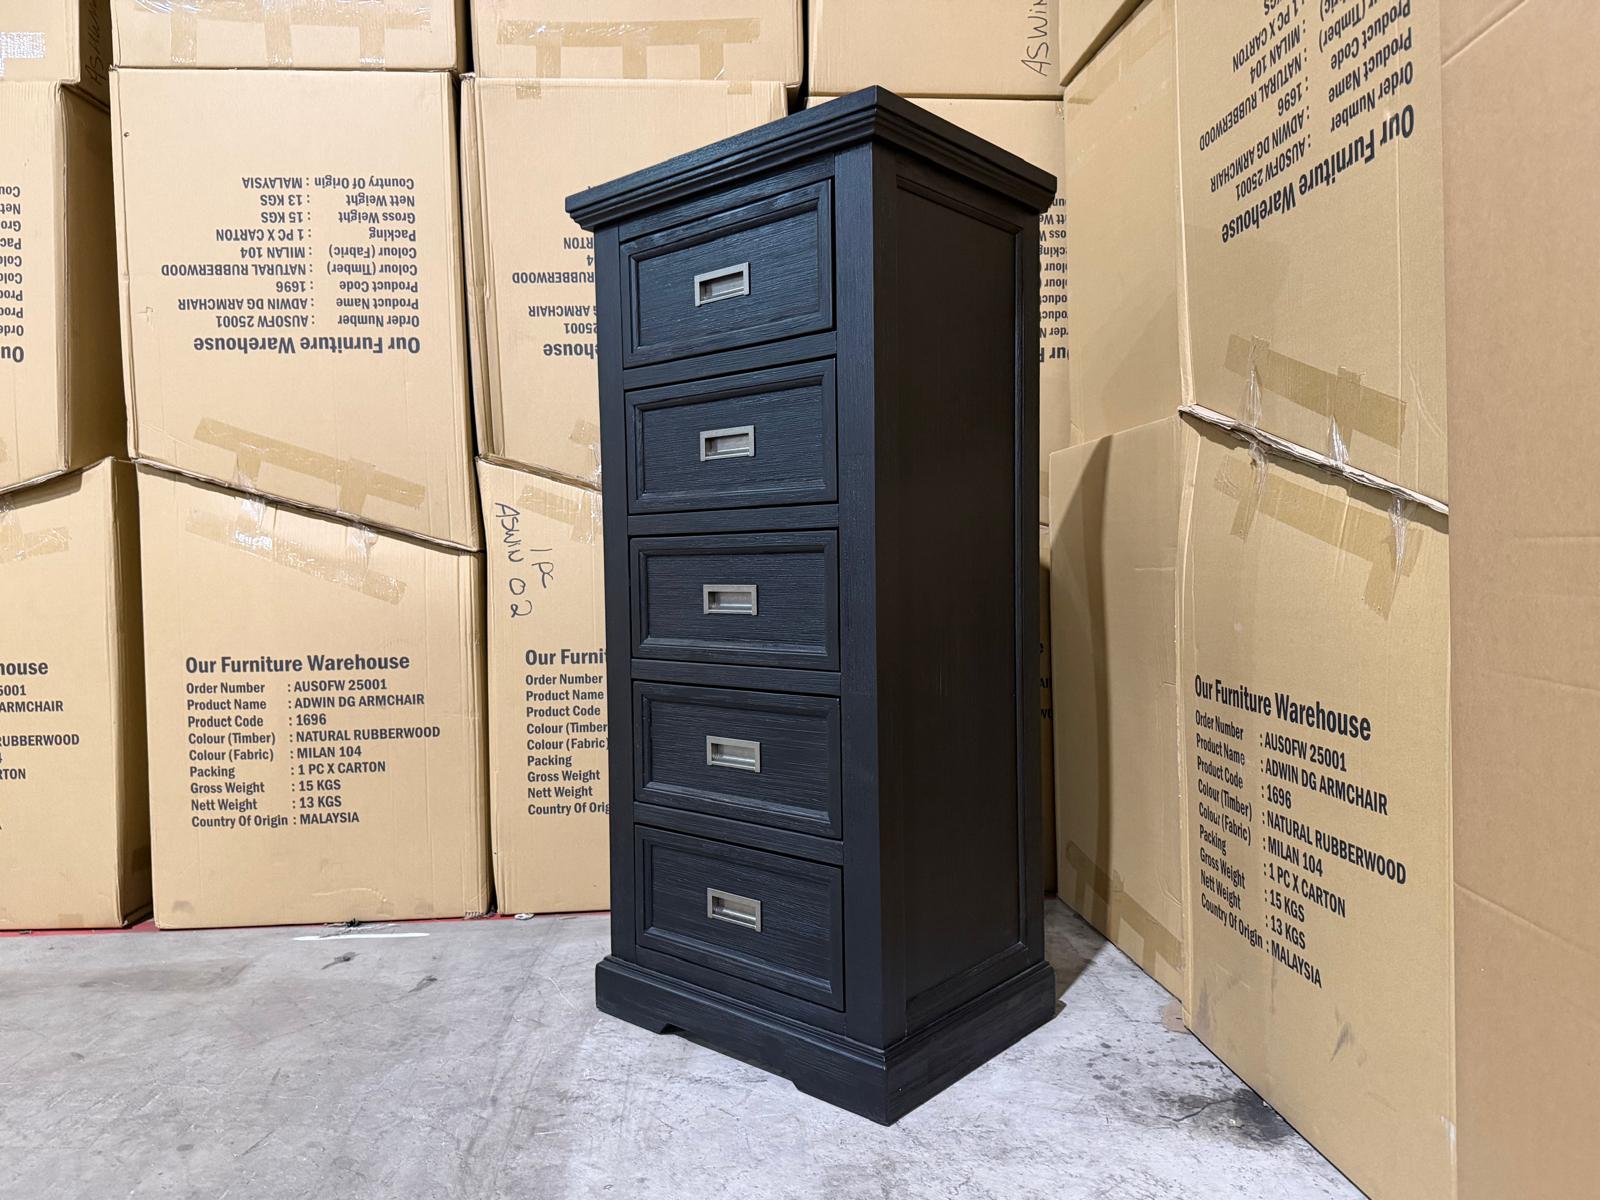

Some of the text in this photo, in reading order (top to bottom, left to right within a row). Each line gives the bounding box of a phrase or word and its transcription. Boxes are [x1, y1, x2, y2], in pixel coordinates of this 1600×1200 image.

[1276, 4, 1290, 31] PC
[1268, 18, 1276, 40] X
[1232, 27, 1268, 73] CARTON
[1249, 24, 1300, 84] MILAN 104
[1277, 36, 1359, 117] Code 1696
[1199, 52, 1302, 151] NATURAL RUBBERWOOD
[1210, 26, 1412, 193] Product Name ADWIN DG ARMCHAIR
[1235, 61, 1413, 201] Order Number AUSOFW 25001
[241, 174, 414, 190] Country Of Origin MALAYSIA
[1221, 104, 1414, 243] Our Furniture Warehouse
[259, 192, 415, 207] Nett Weight 13 KGS
[260, 208, 415, 224] Gross Weight 15 KGS
[216, 226, 416, 242] Packing 1 PC X CARTON
[239, 244, 417, 259] Colour (Fabric) MILAN 104
[161, 261, 417, 276] Colour (Timber) NATURAL RUBBERWOOD
[275, 280, 418, 293] Product Code 1696
[512, 272, 595, 284] RUBBERWOOD
[178, 297, 419, 310] Product Name ADWIN DG ARMCHAIR
[528, 305, 590, 317] ARMCHAIR
[215, 314, 420, 328] Order Number AUSOFW 25001
[193, 336, 420, 354] Our Furniture Warehouse
[185, 653, 410, 674] Our Furniture Warehouse
[525, 649, 556, 666] Our
[186, 678, 387, 694] Order Number AUSOFW 25001
[525, 673, 603, 685] Order Number
[186, 693, 425, 710] Product Name ADWIN DG ARMCHAIR
[525, 689, 604, 702] Product Name
[0, 701, 64, 713] ARMCHAIR
[526, 704, 601, 718] Product Code
[1194, 674, 1371, 741] Our Furniture Warehouse
[187, 712, 327, 728] Product Code 1696
[526, 723, 563, 734] Colour
[188, 726, 440, 746] Colour (Timber) NATURAL RUBBERWOOD
[526, 739, 564, 750] Colour
[1195, 709, 1347, 772] Order Number AUSOFW 25001
[188, 745, 362, 763] Colour (Fabric) MILAN 104
[527, 754, 572, 768] Packing
[189, 760, 386, 780] Packing 1 PC X CARTON
[527, 769, 600, 783] Gross Weight
[1196, 732, 1388, 816] Product ADWIN DG ARMCHAIR
[190, 778, 341, 796] Gross Weight 15 KGS
[1196, 755, 1292, 809] Product Code 1696
[527, 785, 593, 799] Nett Weight
[191, 795, 342, 813] Nett Weight 13 KGS
[527, 801, 587, 816] Country Of
[191, 811, 360, 829] Country Of Origin MALAYSIA
[1266, 809, 1406, 884] NATURAL RUBBERWOOD
[1267, 835, 1323, 877] MILAN 104
[1269, 862, 1345, 918] 1 PC X CARTON
[1269, 889, 1305, 923] 15 KGS
[1270, 914, 1306, 950] 13 KGS
[1271, 939, 1322, 988] MALAYSIA
